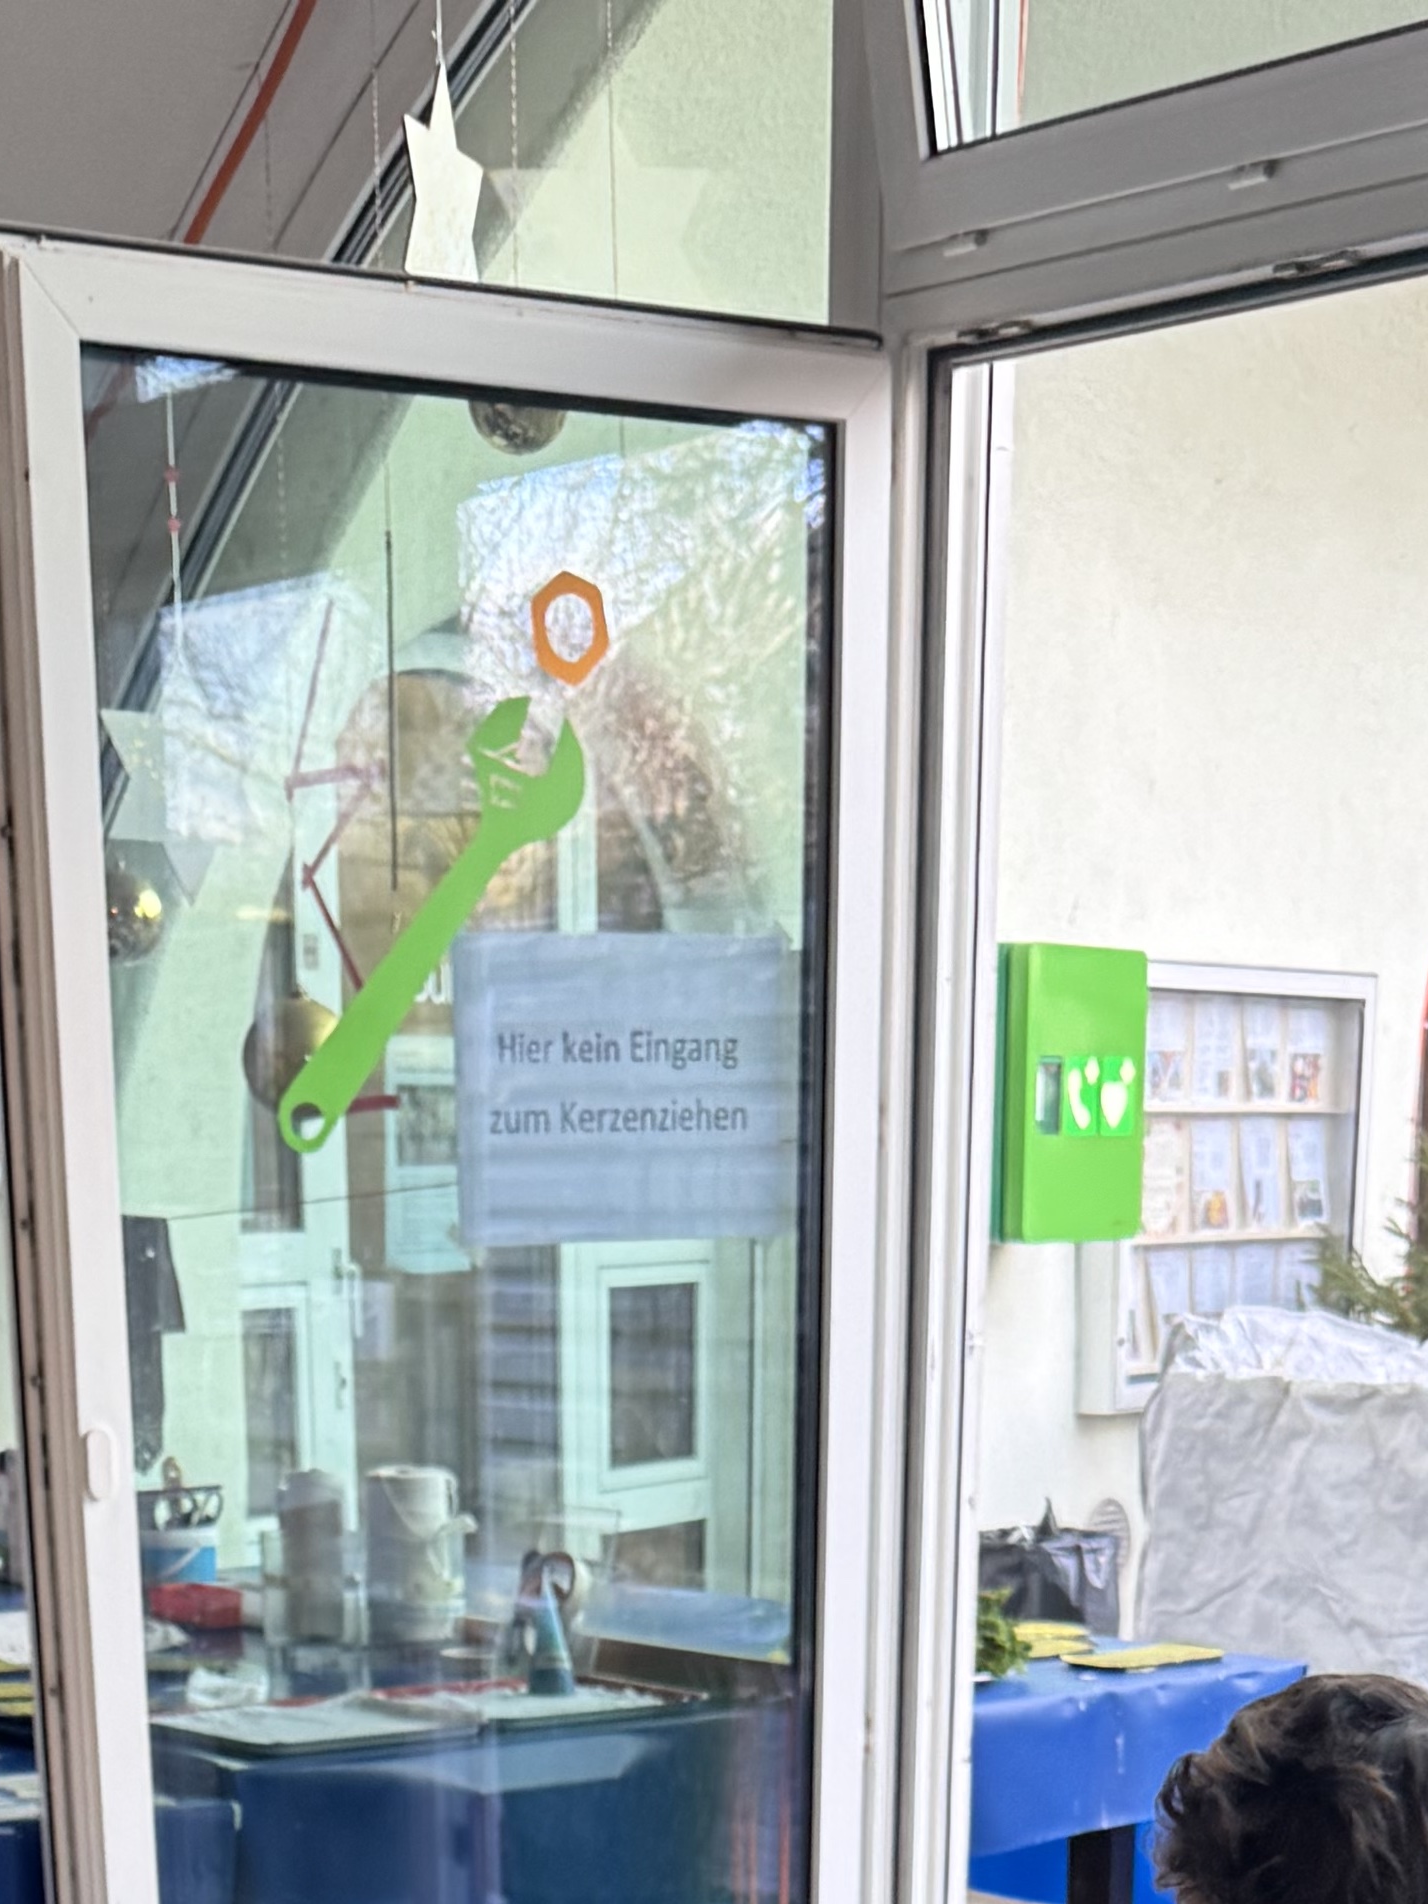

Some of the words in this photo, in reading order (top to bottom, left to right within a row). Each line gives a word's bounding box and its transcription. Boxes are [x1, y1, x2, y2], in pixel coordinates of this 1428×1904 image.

[497, 1031, 553, 1064] Hier
[561, 1031, 621, 1064] kein
[629, 1029, 740, 1071] Eingang
[489, 1108, 551, 1136] zum
[560, 1099, 749, 1135] Kerzenziehen
